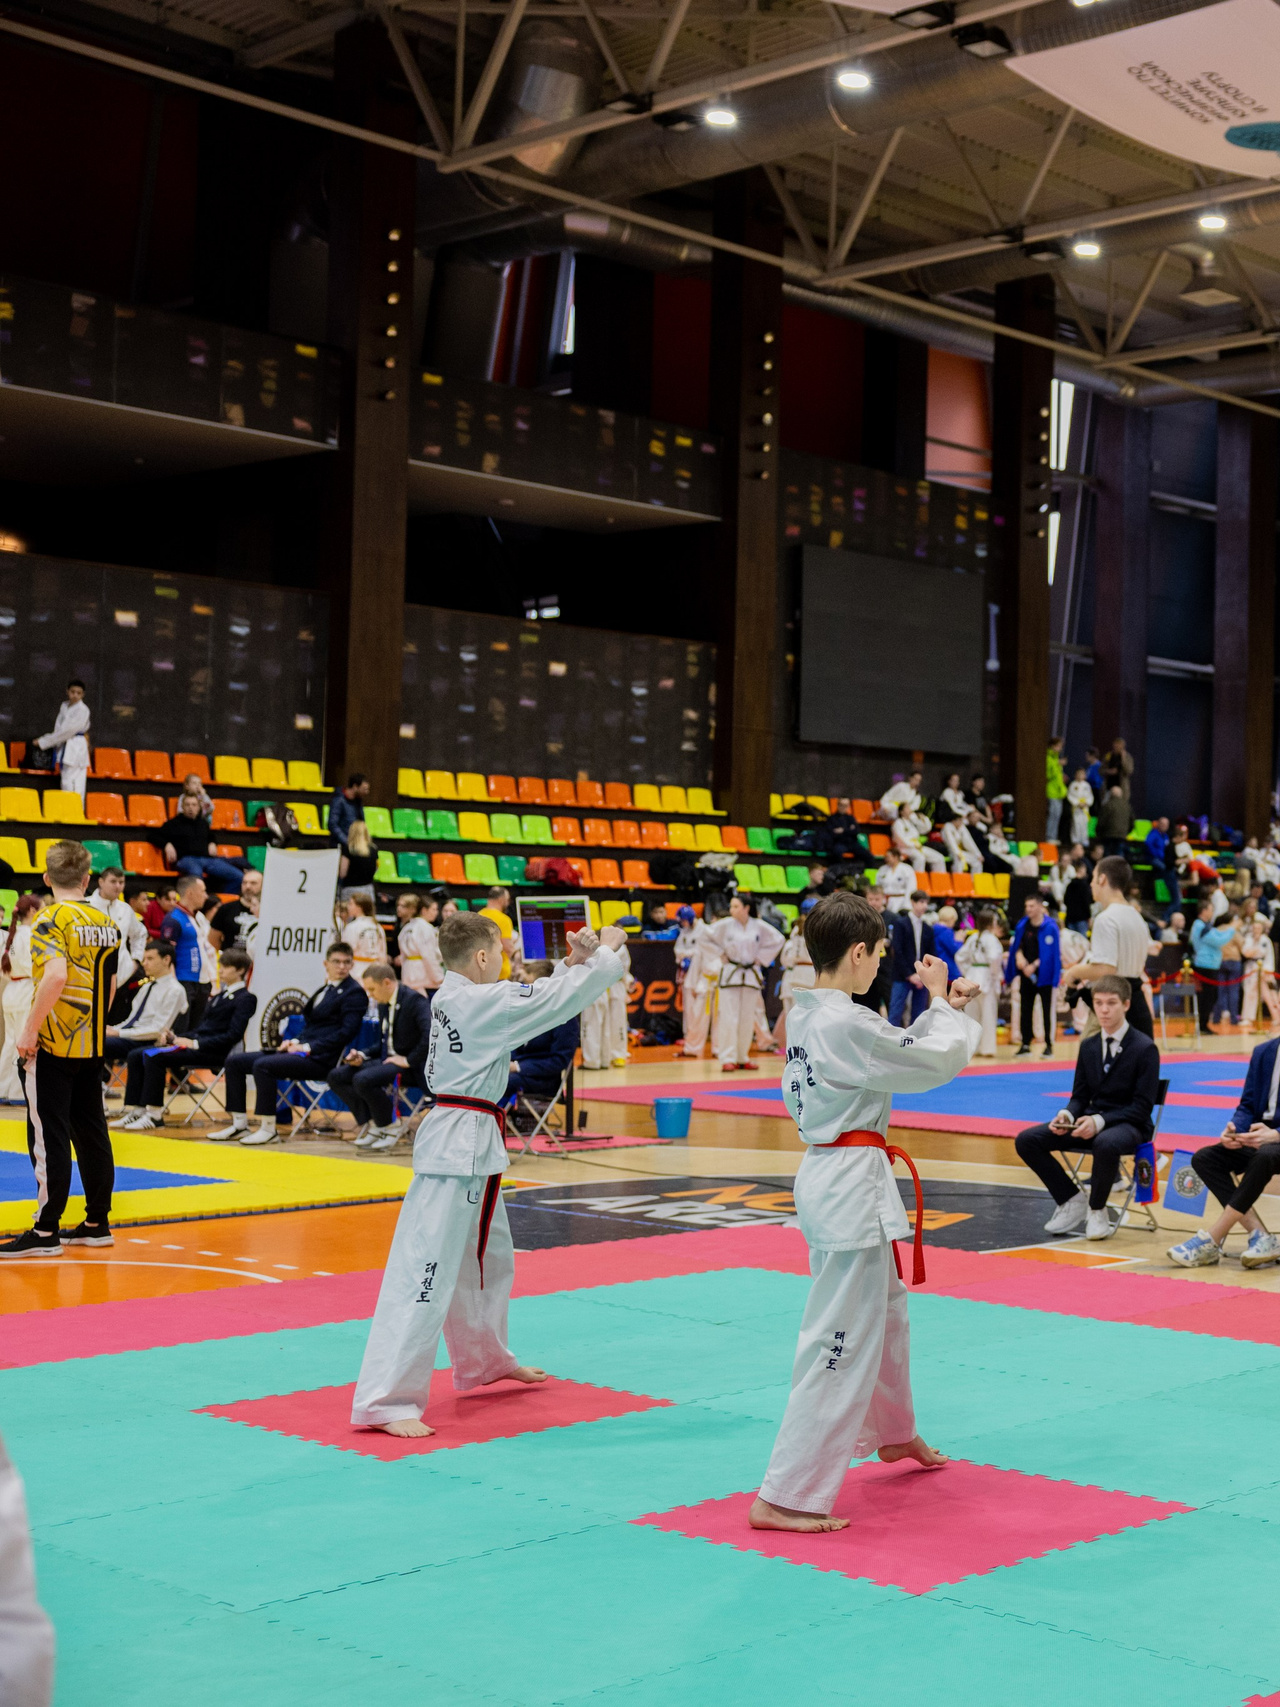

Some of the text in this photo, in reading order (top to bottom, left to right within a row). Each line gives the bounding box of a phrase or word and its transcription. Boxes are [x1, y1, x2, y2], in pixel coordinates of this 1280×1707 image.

[1127, 66, 1212, 124] КОМИТЕТ ПО
[1140, 60, 1230, 121] ФИЗИЧЕСКОЙ
[1187, 78, 1248, 118] КУЛЬТУРЕ
[1201, 71, 1268, 113] И СПОРТУ
[298, 869, 307, 893] 2
[266, 927, 327, 956] ДОЯНГ
[431, 1007, 463, 1053] WON-DO
